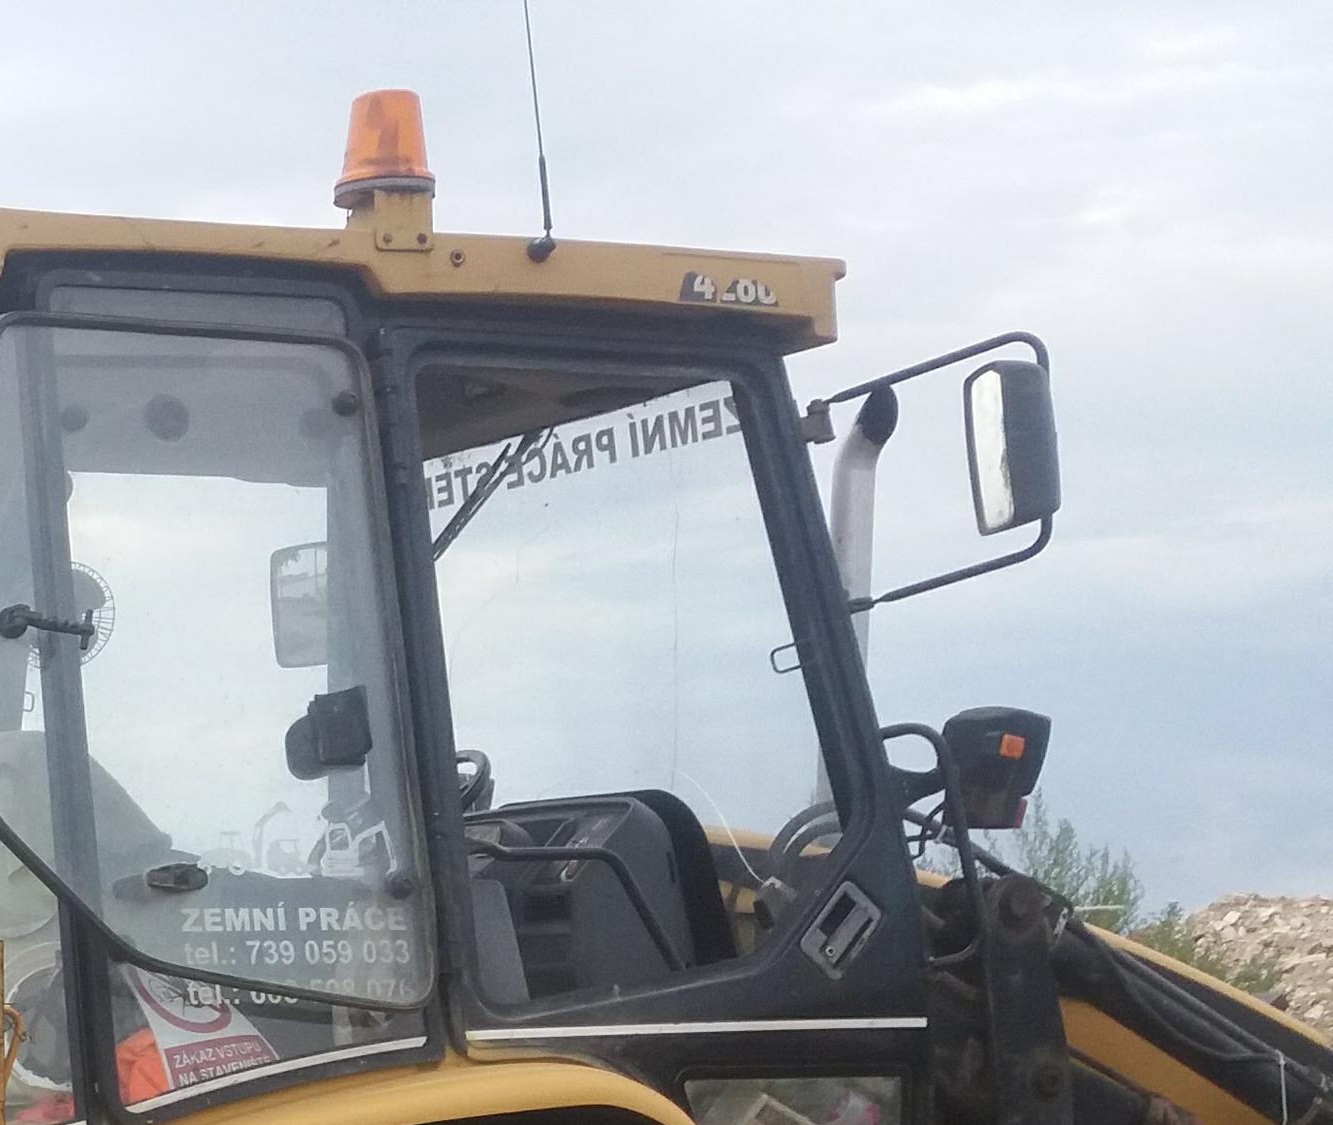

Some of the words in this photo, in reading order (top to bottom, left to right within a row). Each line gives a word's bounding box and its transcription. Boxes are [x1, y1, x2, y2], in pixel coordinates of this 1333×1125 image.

[181, 902, 286, 932] ZEMNÍ
[298, 902, 408, 932] PRÁCE
[184, 940, 237, 965] tel.:
[245, 940, 296, 965] 739
[304, 940, 354, 965] 059
[363, 939, 411, 965] 033
[173, 1047, 216, 1069] ZÁKAZ
[215, 1040, 262, 1059] VSTUPU
[178, 1071, 199, 1087] NA
